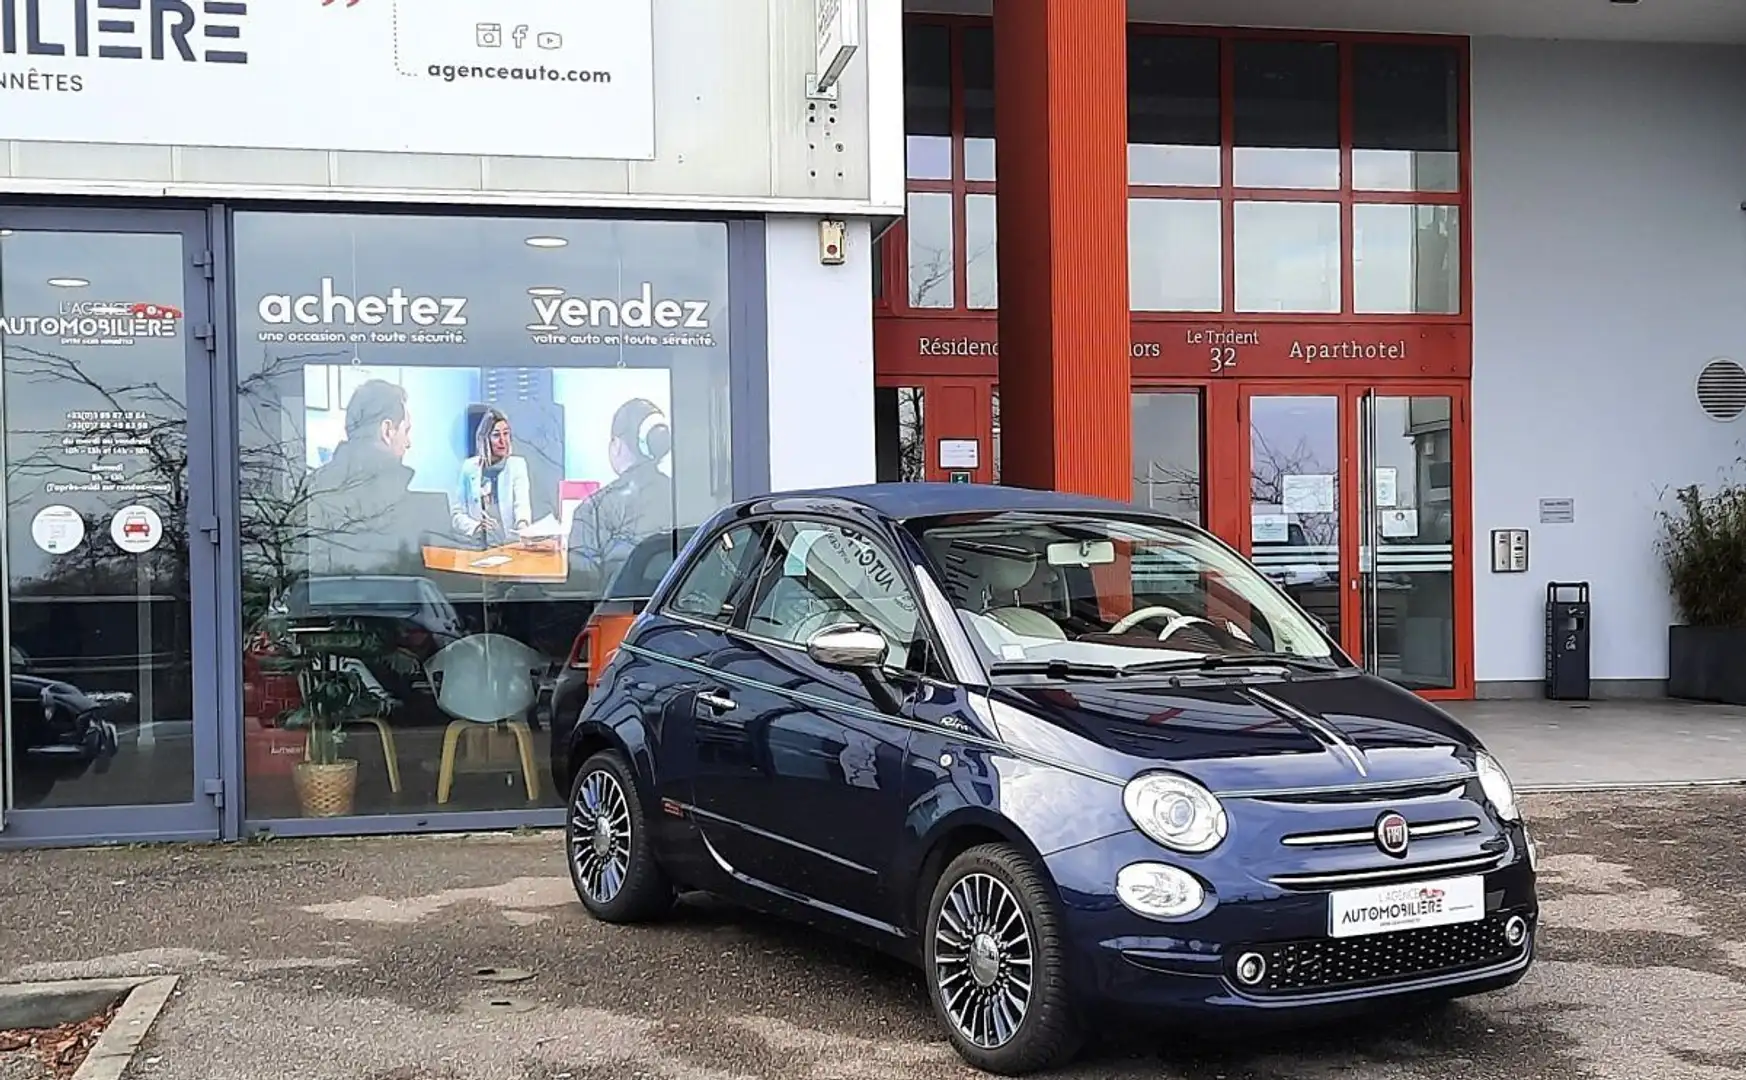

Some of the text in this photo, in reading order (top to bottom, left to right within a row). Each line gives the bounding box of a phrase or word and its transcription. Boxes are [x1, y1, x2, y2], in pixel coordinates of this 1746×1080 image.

[427, 64, 612, 83] agenceauto.com
[258, 277, 468, 325] achetez
[531, 282, 709, 329] vendez
[258, 328, 467, 345] une occasion en toute sécurité.
[532, 331, 716, 347] votre auto en toute sérénité.
[1187, 329, 1260, 345] Le Trident
[1210, 347, 1237, 373] 32
[1289, 340, 1406, 363] Aparthotel
